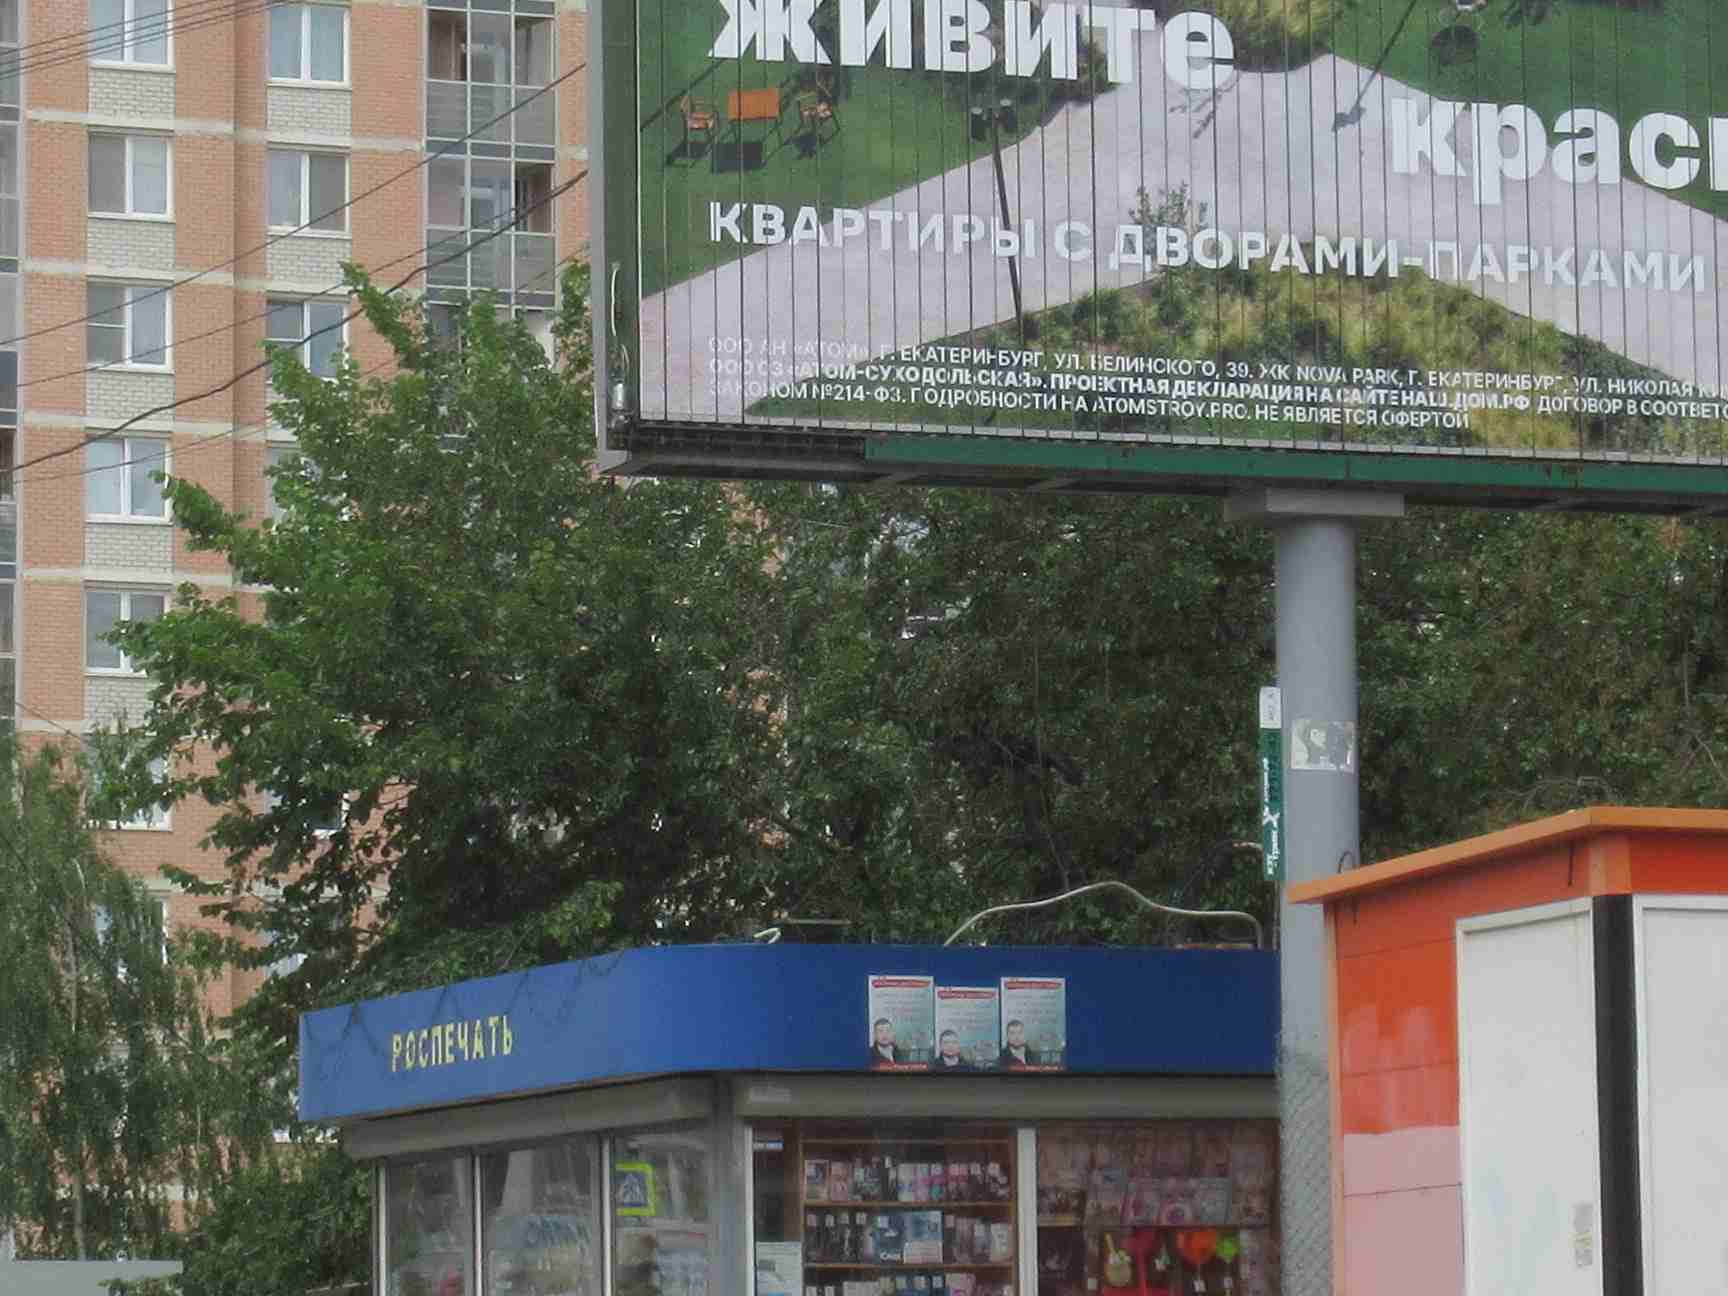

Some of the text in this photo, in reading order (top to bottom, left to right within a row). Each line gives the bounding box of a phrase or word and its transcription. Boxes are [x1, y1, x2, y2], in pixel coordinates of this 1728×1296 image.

[710, 201, 1705, 292] КВАРТИРЫ С ДВОРАМИ-ПАРКАМИ
[1049, 372, 1169, 396] ПРОЕКТНАЯ
[1536, 396, 1623, 417] ДОГОВОР
[1055, 352, 1087, 371] УЛ.
[1297, 365, 1346, 384] NOVA
[1352, 368, 1403, 389] PARK,
[1608, 377, 1694, 398] НИКОЛАЯ
[1255, 405, 1279, 422] НЕ
[1282, 406, 1378, 426] ЯВЛЯЕТСЯ
[391, 1014, 513, 1073] РОСПЕЧАТЬ
